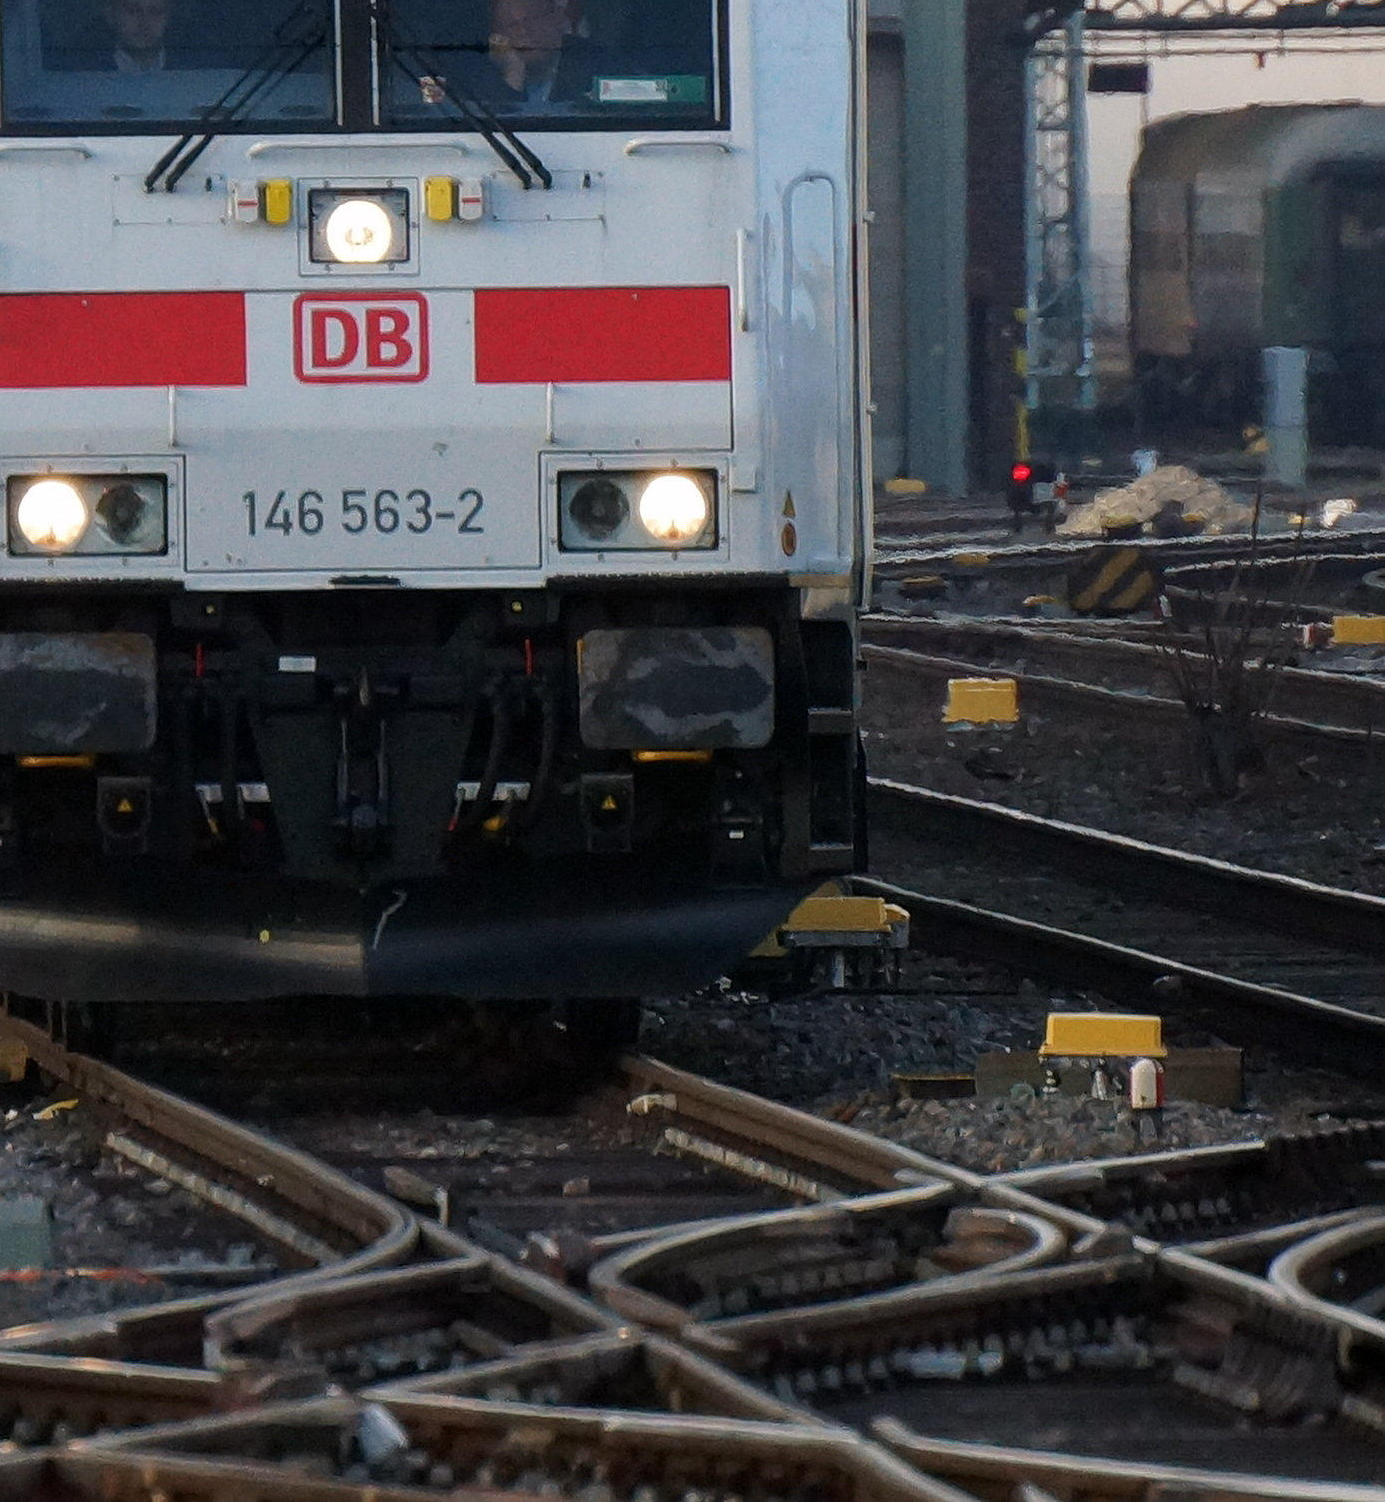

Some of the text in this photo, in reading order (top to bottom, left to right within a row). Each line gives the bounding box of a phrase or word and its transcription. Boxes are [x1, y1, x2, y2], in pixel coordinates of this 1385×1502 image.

[310, 307, 413, 369] DB
[241, 487, 485, 536] 146 563-2
